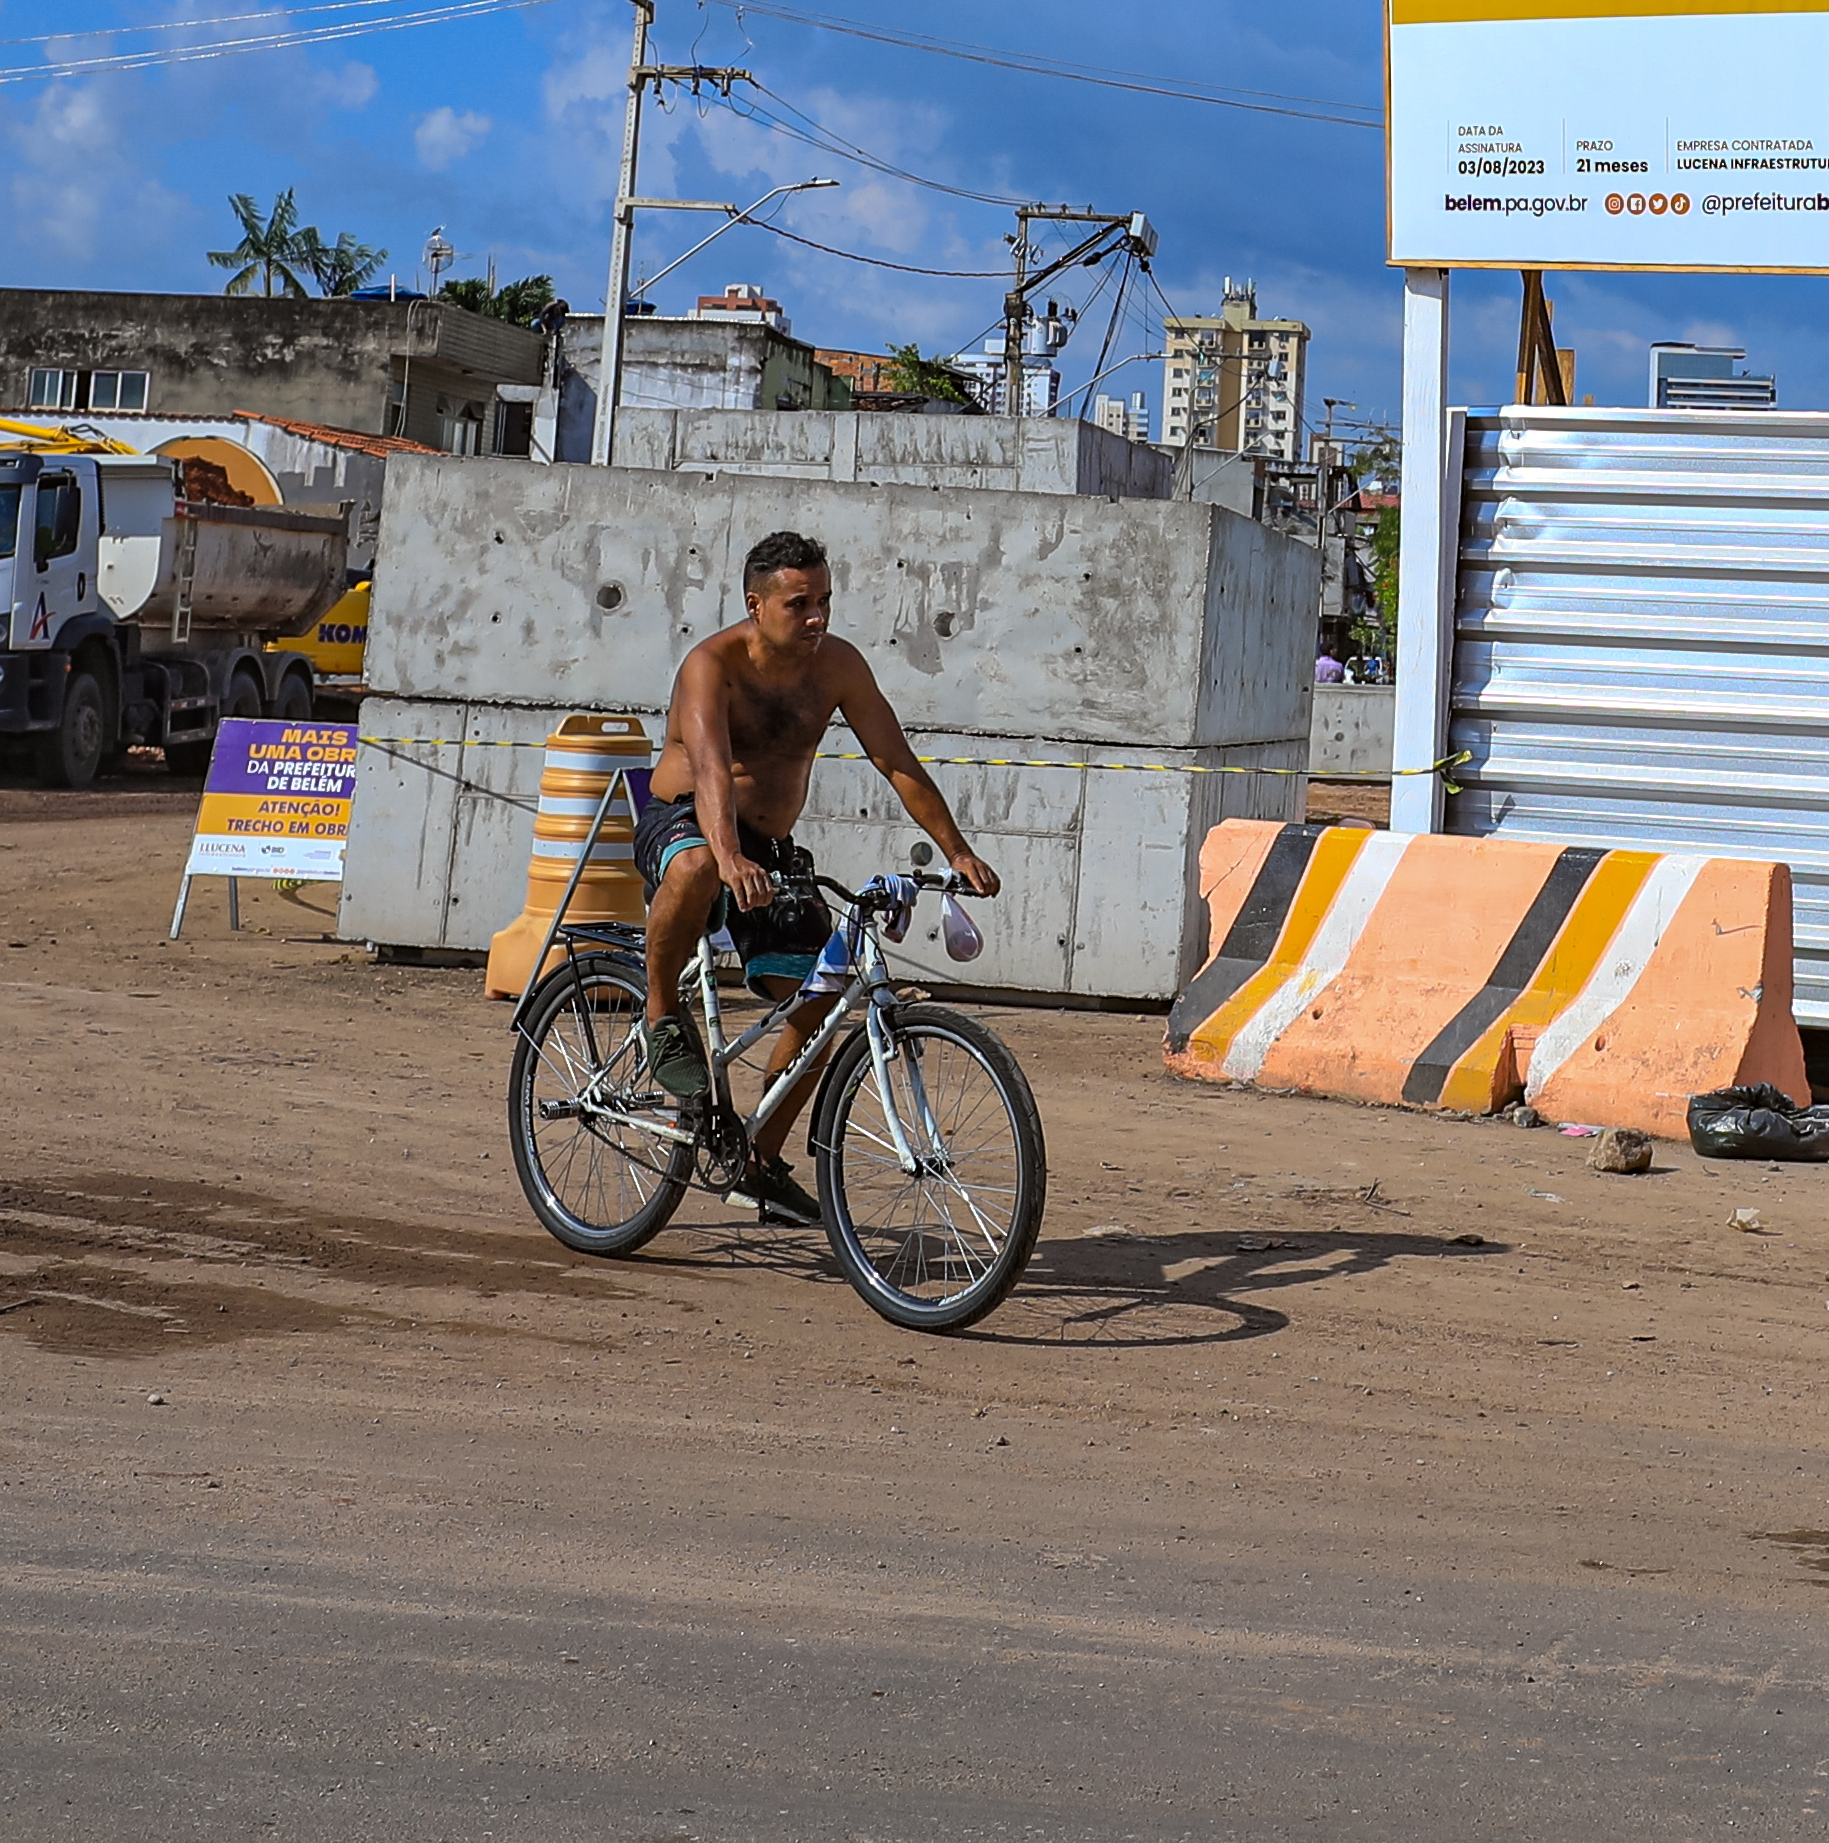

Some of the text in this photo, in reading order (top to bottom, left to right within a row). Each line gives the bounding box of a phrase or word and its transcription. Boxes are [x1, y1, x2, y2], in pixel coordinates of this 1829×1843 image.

[1458, 126, 1503, 136] DATA DA
[1458, 143, 1522, 153] ASSINATURA
[1576, 141, 1613, 151] PRAZO
[1677, 140, 1813, 151] EMPRESA CONTRATADA
[1458, 158, 1544, 177] 03/08/2023
[1576, 158, 1648, 173] 21 meses
[1677, 158, 1728, 170] LUCENA
[1445, 194, 1588, 217] belem.pa.gov.br
[318, 623, 367, 644] KOM
[281, 728, 349, 746] MAIS
[249, 743, 303, 761] UMA
[247, 760, 270, 775] DA
[267, 775, 343, 793] DE BELÉM
[258, 799, 340, 817] ATENÇÃO!
[227, 819, 348, 836] TRECHO EM OBR
